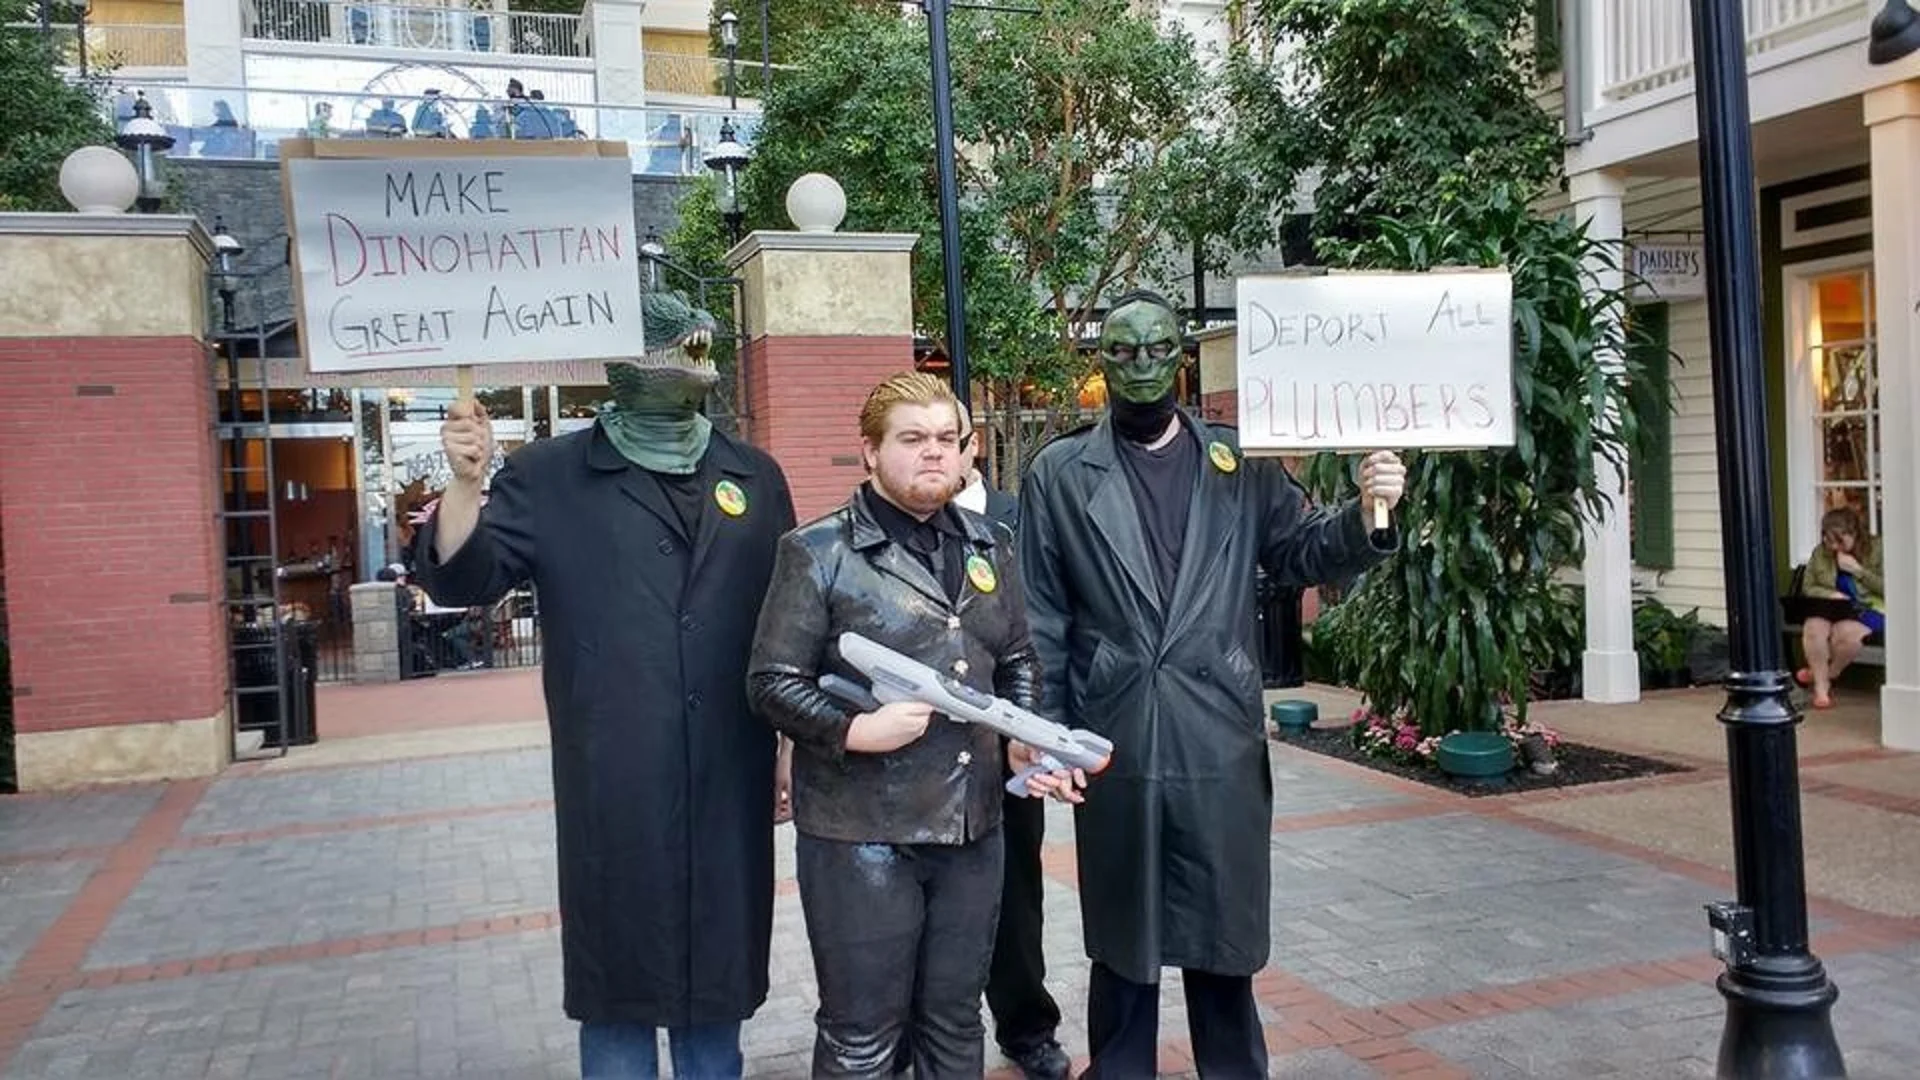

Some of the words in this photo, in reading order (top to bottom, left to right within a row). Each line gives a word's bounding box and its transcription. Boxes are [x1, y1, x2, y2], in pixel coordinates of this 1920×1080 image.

[385, 171, 510, 218] MAKE
[325, 212, 622, 287] DINOHATTAN
[1639, 249, 1699, 277] PAISLEYS
[328, 295, 456, 355] GREAT
[482, 285, 615, 340] AGAIN
[1249, 300, 1389, 356] DEPORT
[1426, 289, 1495, 335] ALL
[1244, 375, 1496, 441] PLUMBERS
